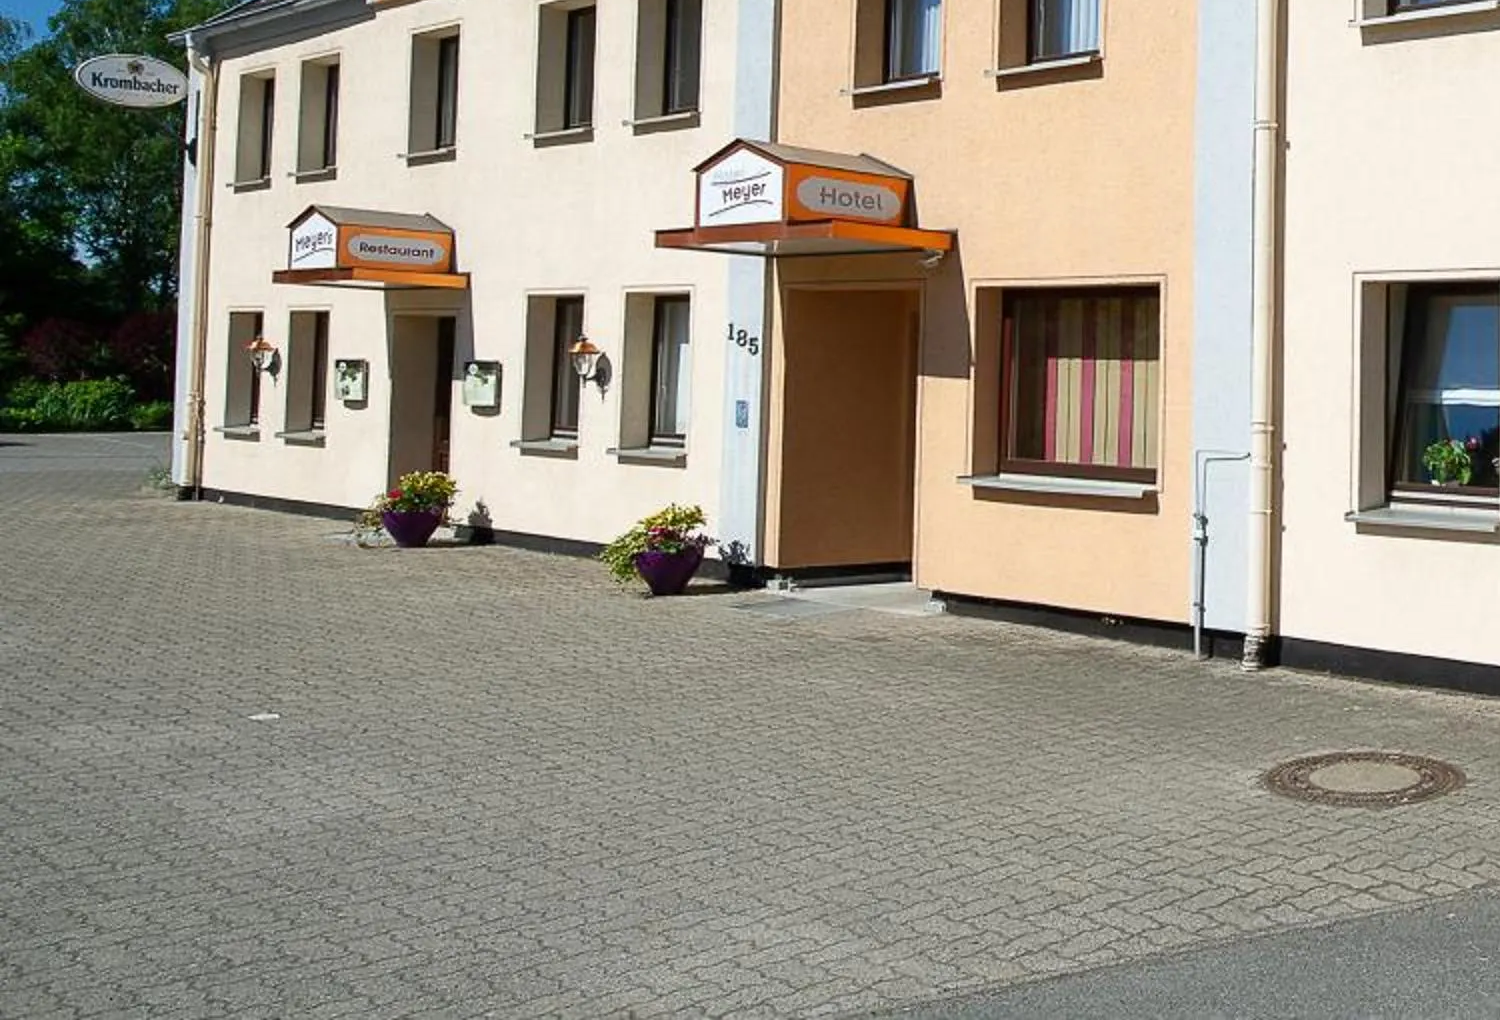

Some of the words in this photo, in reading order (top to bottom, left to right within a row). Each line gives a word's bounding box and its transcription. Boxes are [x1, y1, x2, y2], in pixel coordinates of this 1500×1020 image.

[91, 71, 180, 94] Krombacher
[722, 183, 766, 204] Meyer
[820, 186, 883, 211] Hotel
[359, 241, 435, 259] Restaurant
[728, 323, 759, 356] 185
